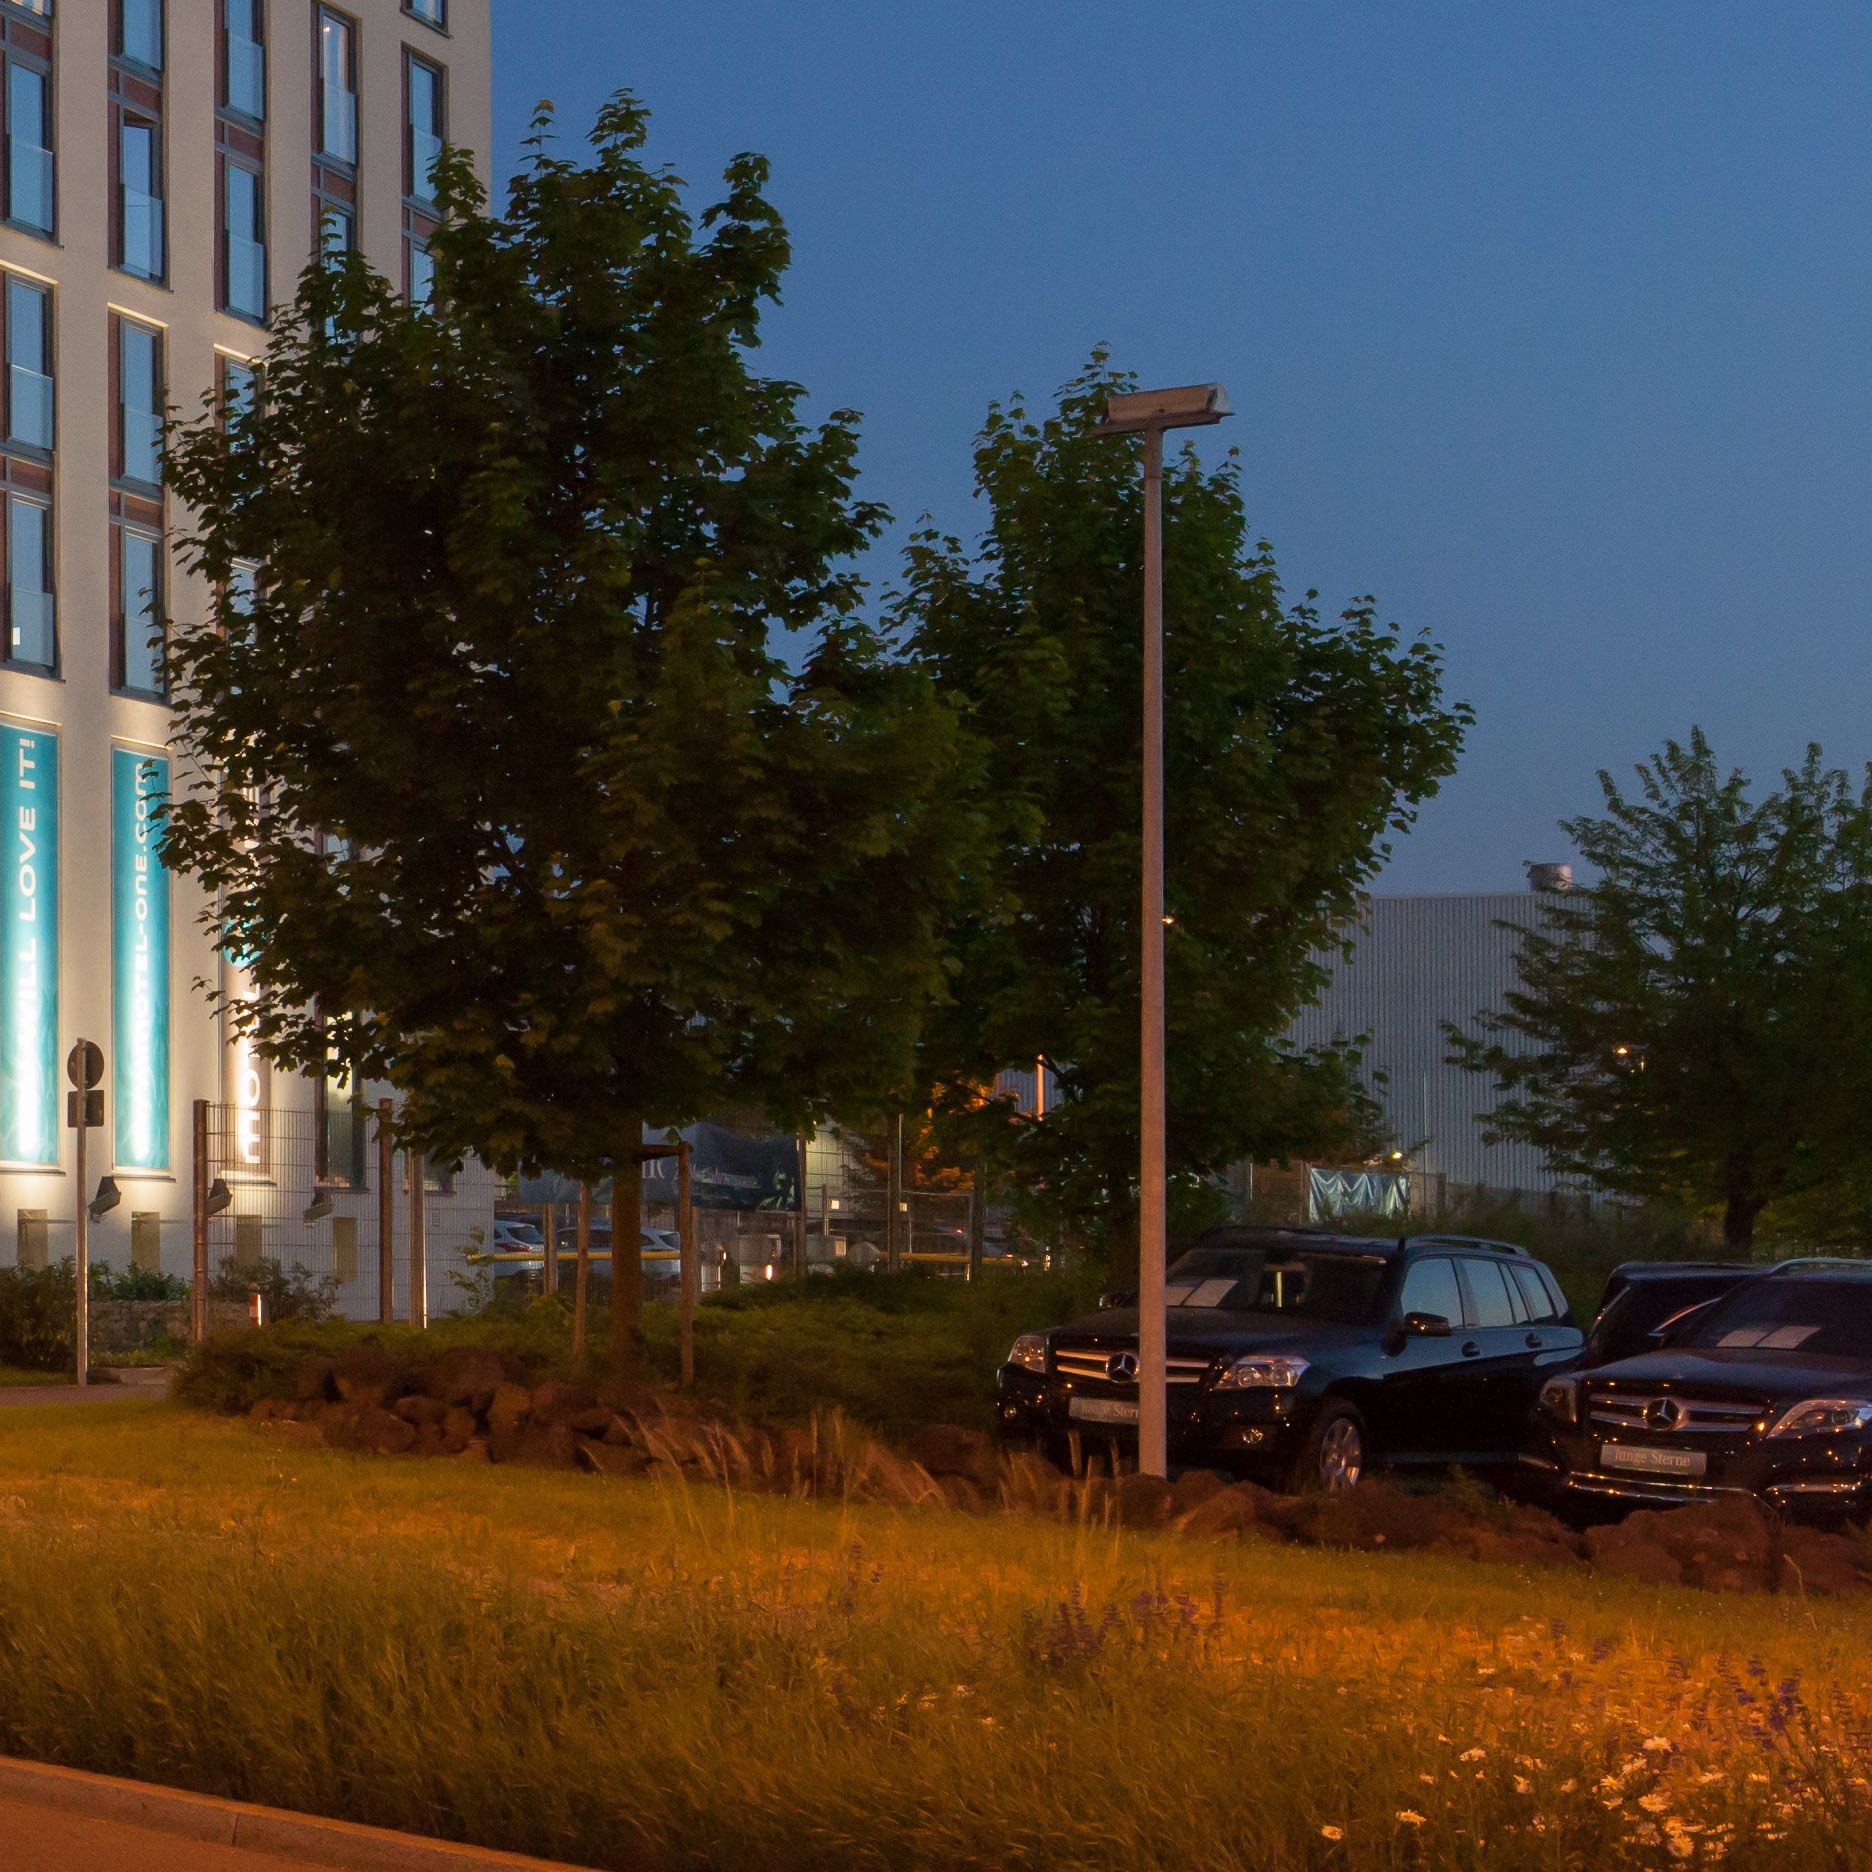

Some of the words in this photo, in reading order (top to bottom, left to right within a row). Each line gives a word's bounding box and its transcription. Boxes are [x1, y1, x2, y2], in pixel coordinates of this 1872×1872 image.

[18, 737, 37, 790] IT!
[18, 806, 37, 922] LOVE
[1651, 1451, 1691, 1467] Sterne
